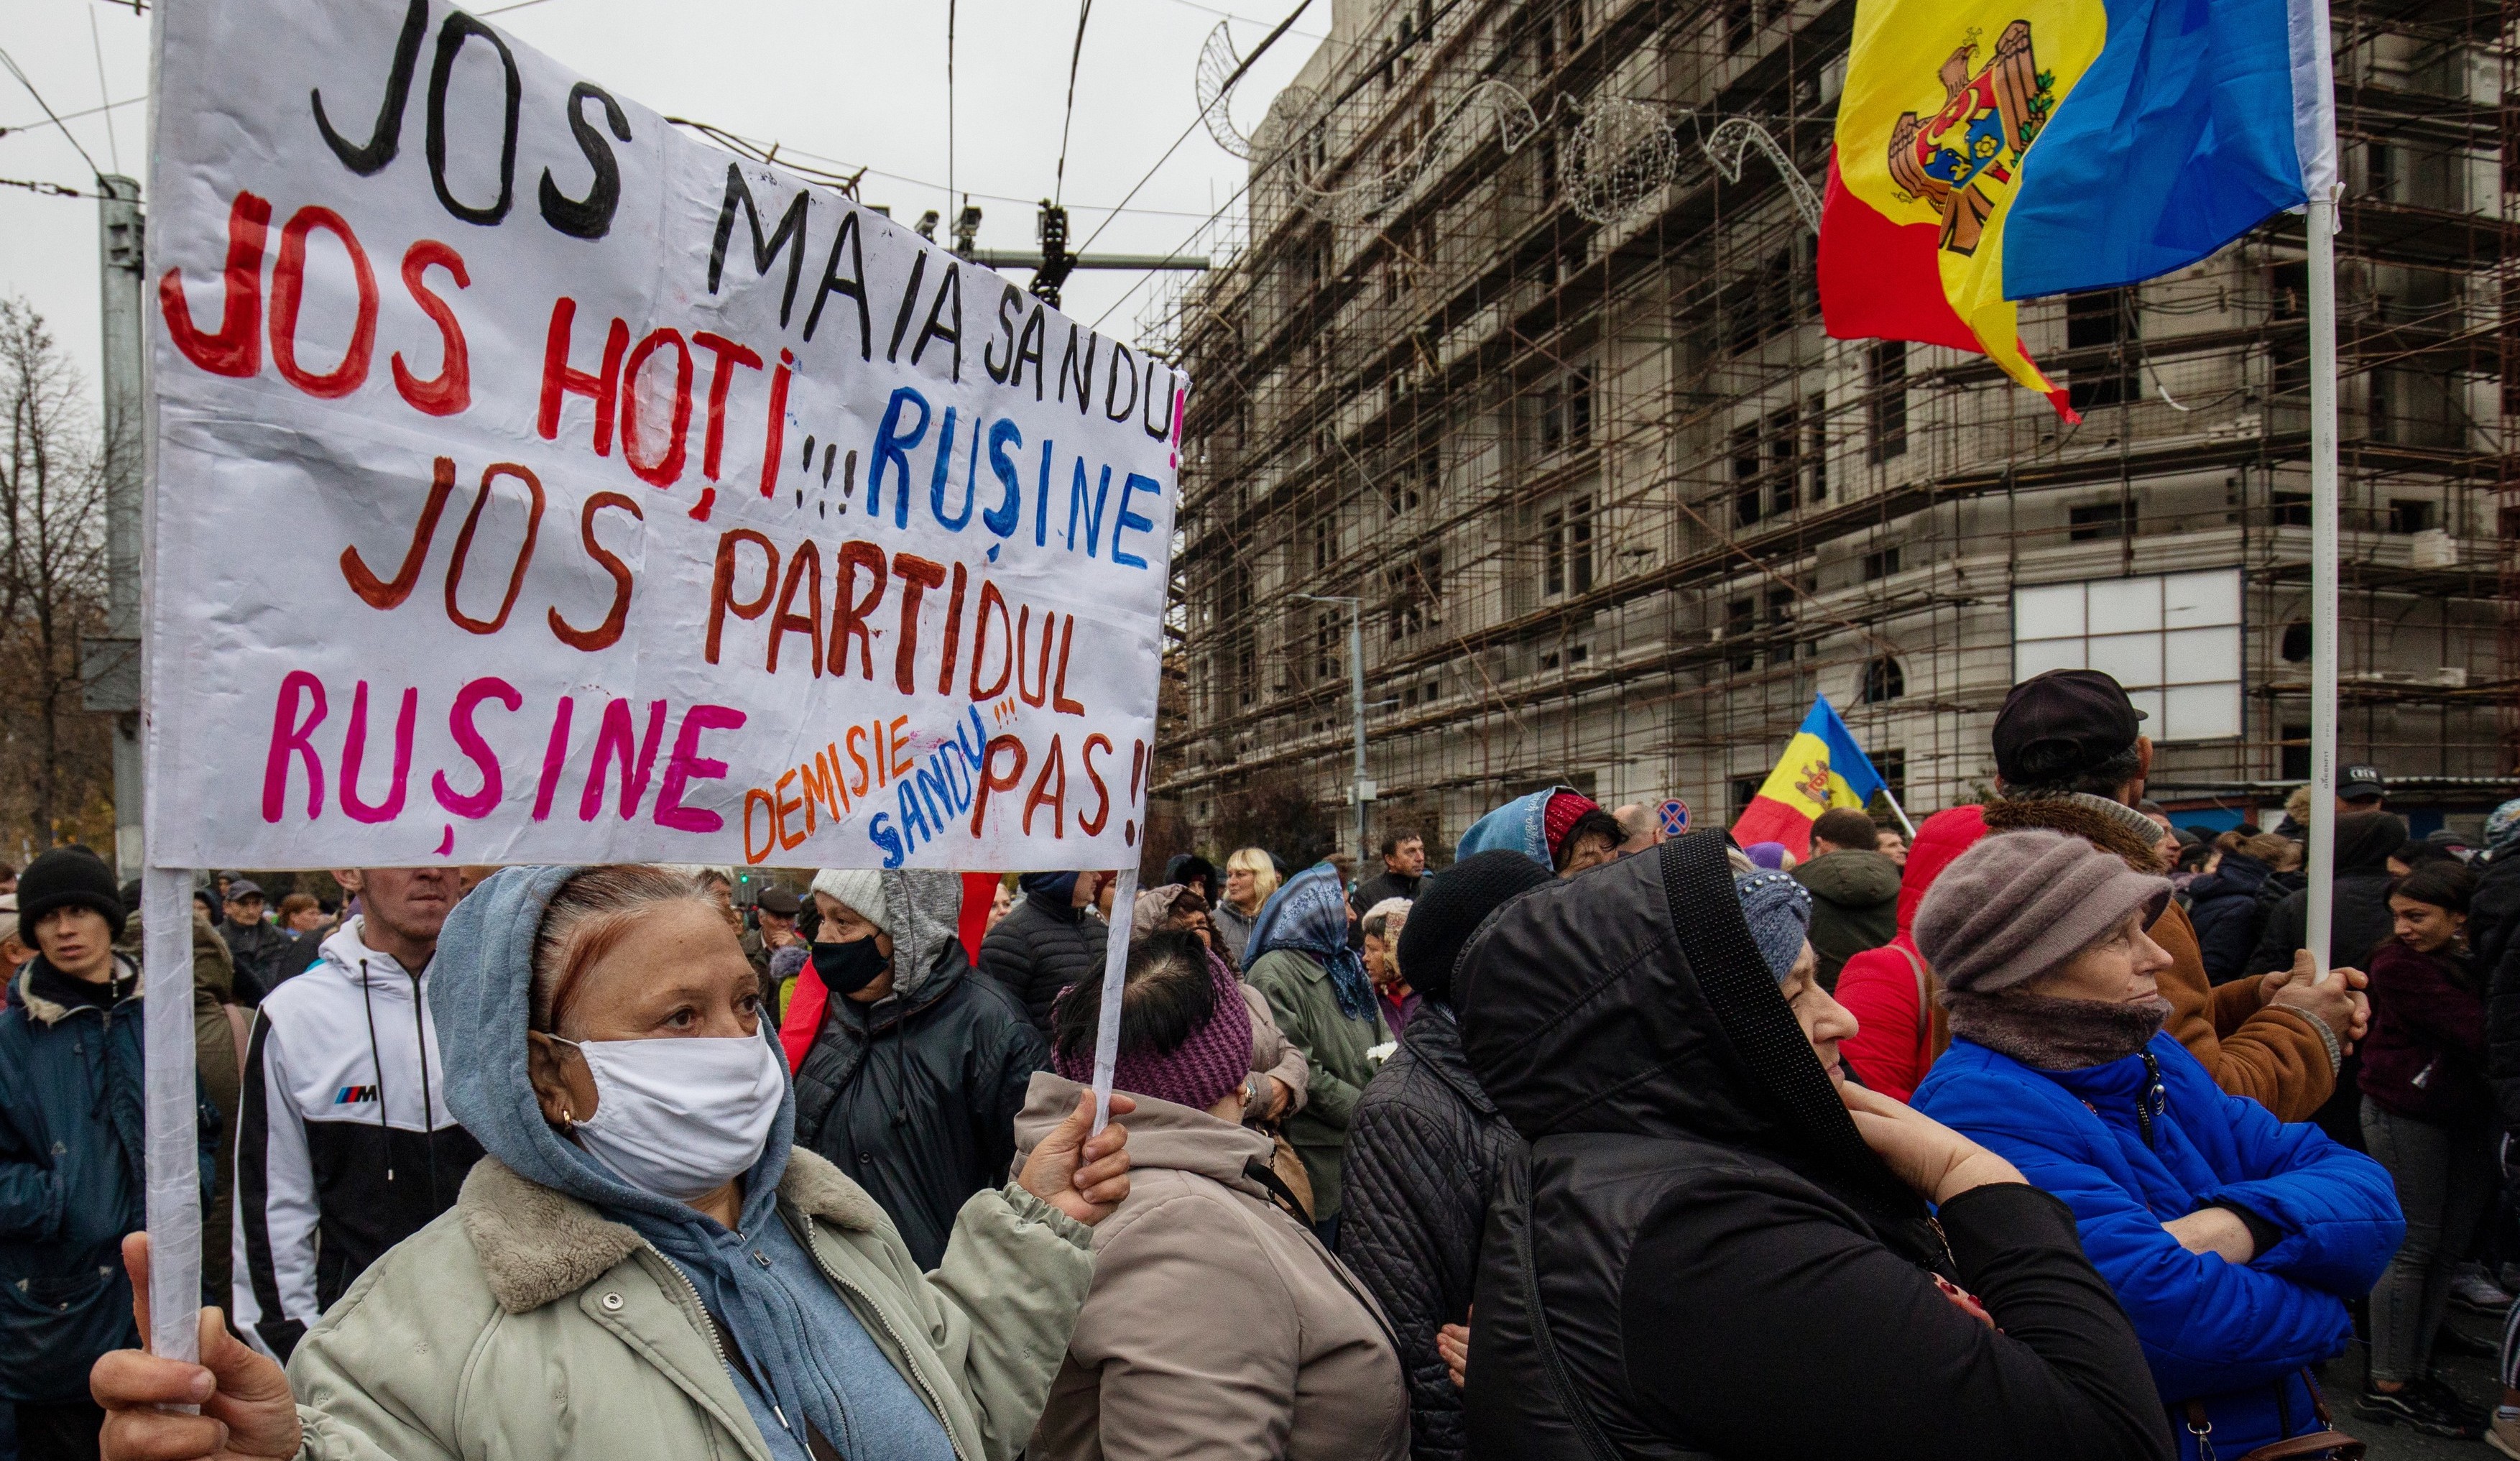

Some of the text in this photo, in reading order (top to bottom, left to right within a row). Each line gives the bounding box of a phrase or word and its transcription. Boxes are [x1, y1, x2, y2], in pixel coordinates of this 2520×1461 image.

[311, 0, 632, 241] JOS
[708, 162, 961, 384] MAIA
[160, 189, 471, 417] JOS
[867, 386, 1161, 570] RUȘINE
[340, 456, 1085, 717] JOS PARTIDUL
[262, 670, 747, 858] RUȘINE
[744, 714, 914, 865] DEMISIE
